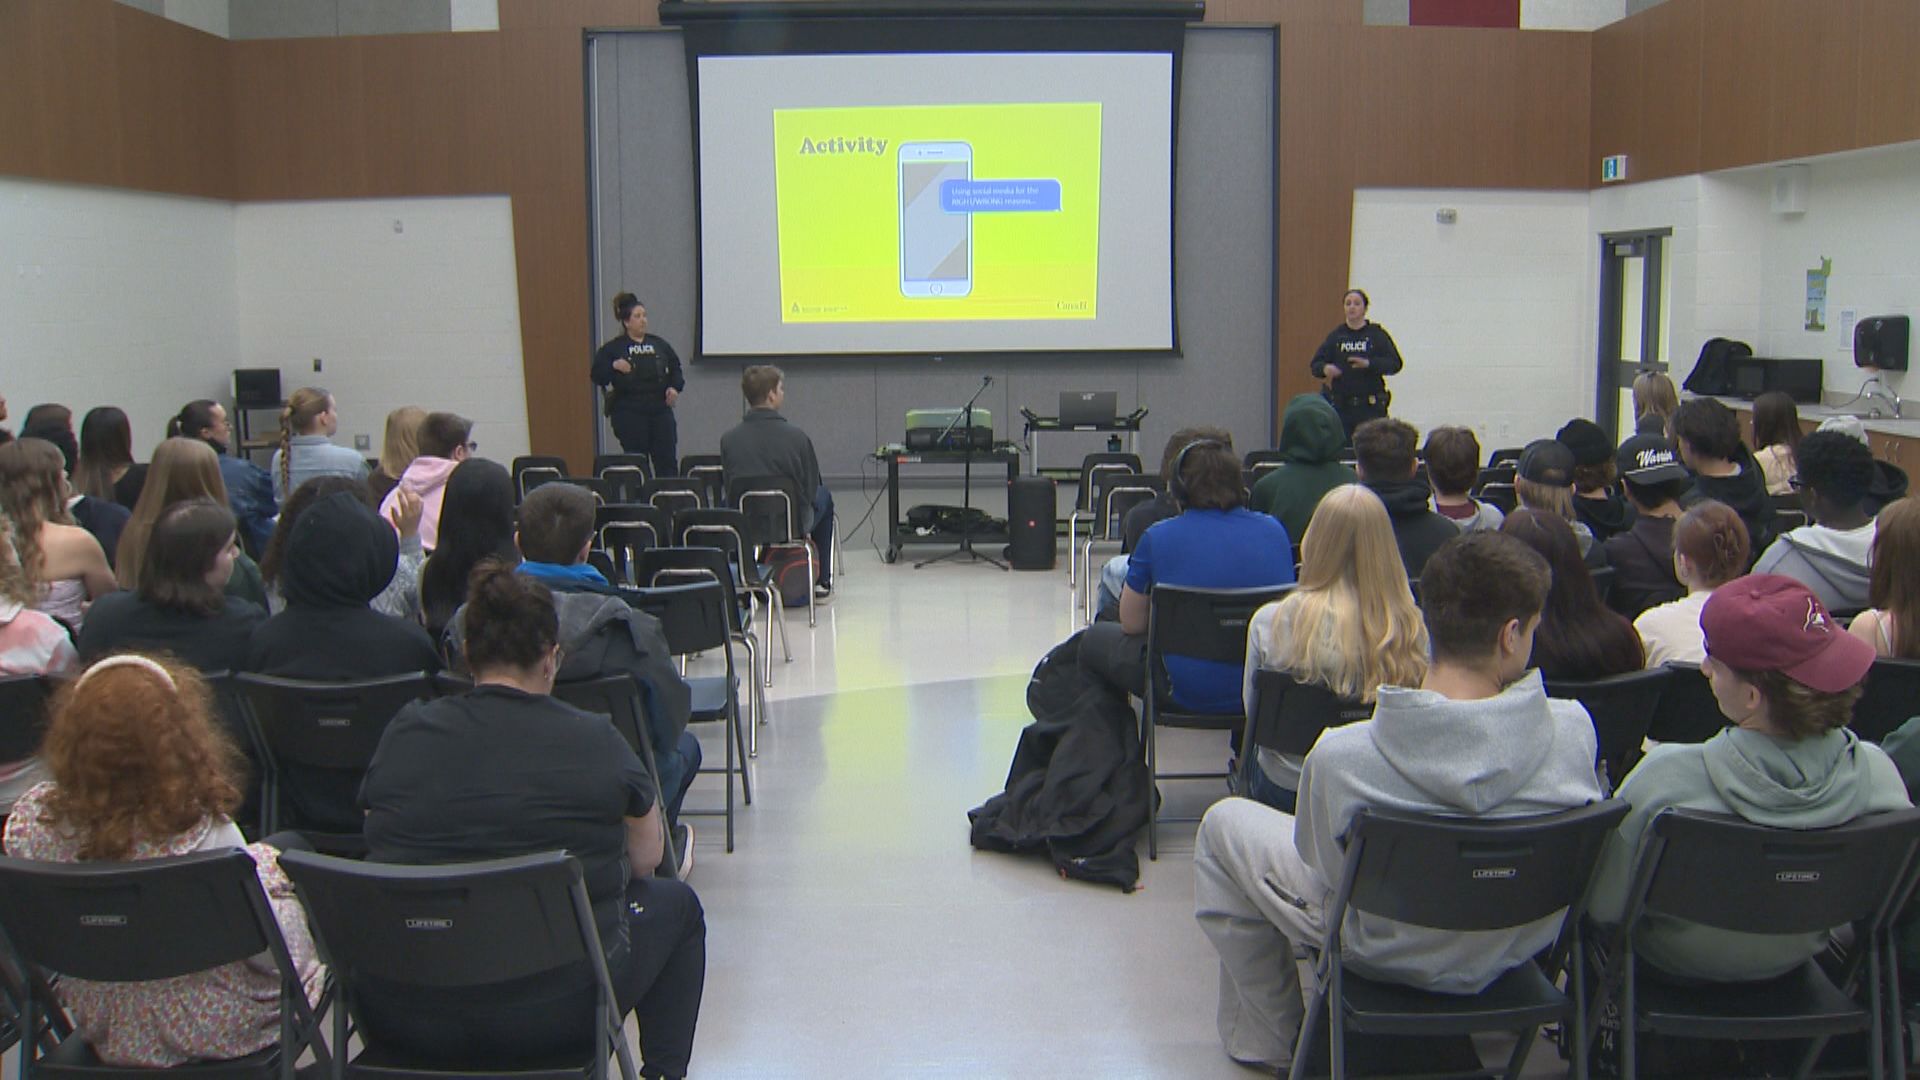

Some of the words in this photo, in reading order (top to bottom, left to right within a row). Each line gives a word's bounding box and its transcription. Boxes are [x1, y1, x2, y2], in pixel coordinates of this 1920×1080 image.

[800, 136, 888, 156] Activity
[952, 186, 971, 196] Using
[972, 185, 992, 195] social
[993, 185, 1014, 195] media
[1015, 185, 1025, 195] for
[1027, 184, 1040, 194] the
[628, 344, 656, 355] POLICE
[1340, 341, 1368, 352] POLICE
